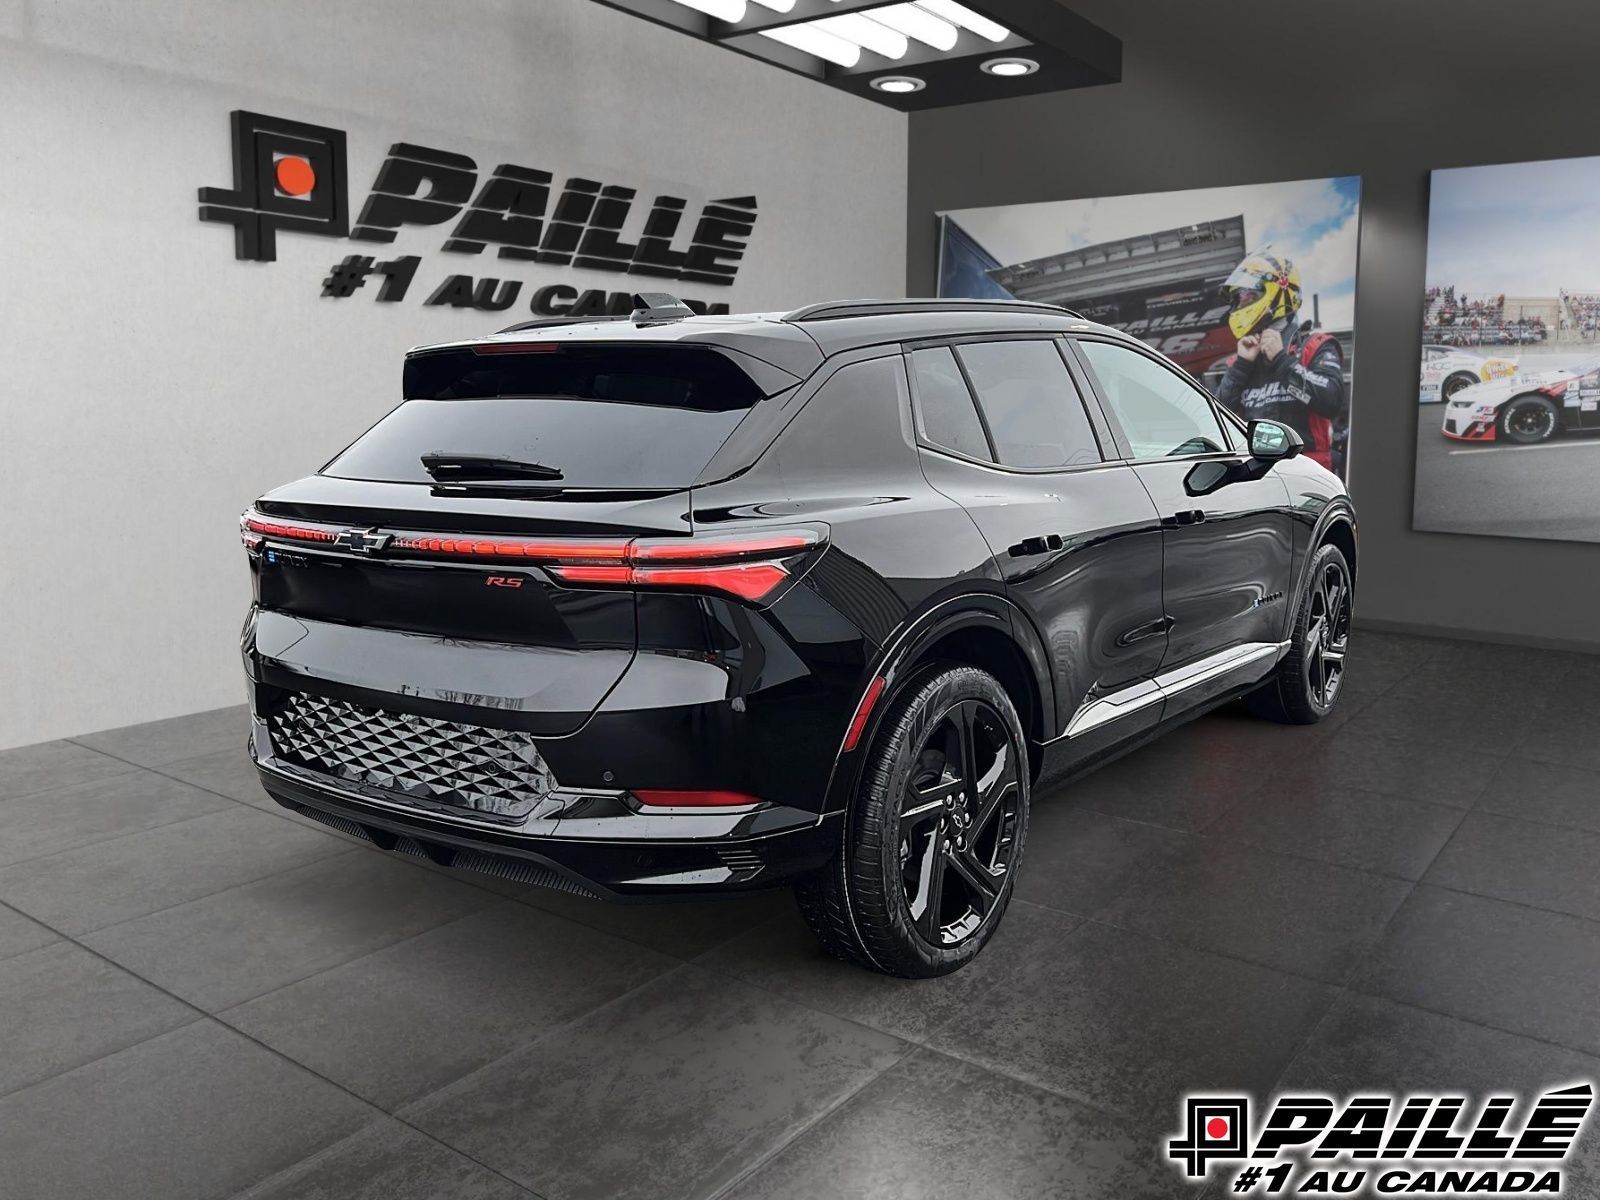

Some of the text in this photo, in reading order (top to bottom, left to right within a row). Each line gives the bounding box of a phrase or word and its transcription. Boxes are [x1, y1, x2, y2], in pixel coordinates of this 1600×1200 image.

[349, 142, 757, 287] PAILLÉ
[320, 254, 730, 316] #1 AU CAN
[485, 576, 524, 588] RS
